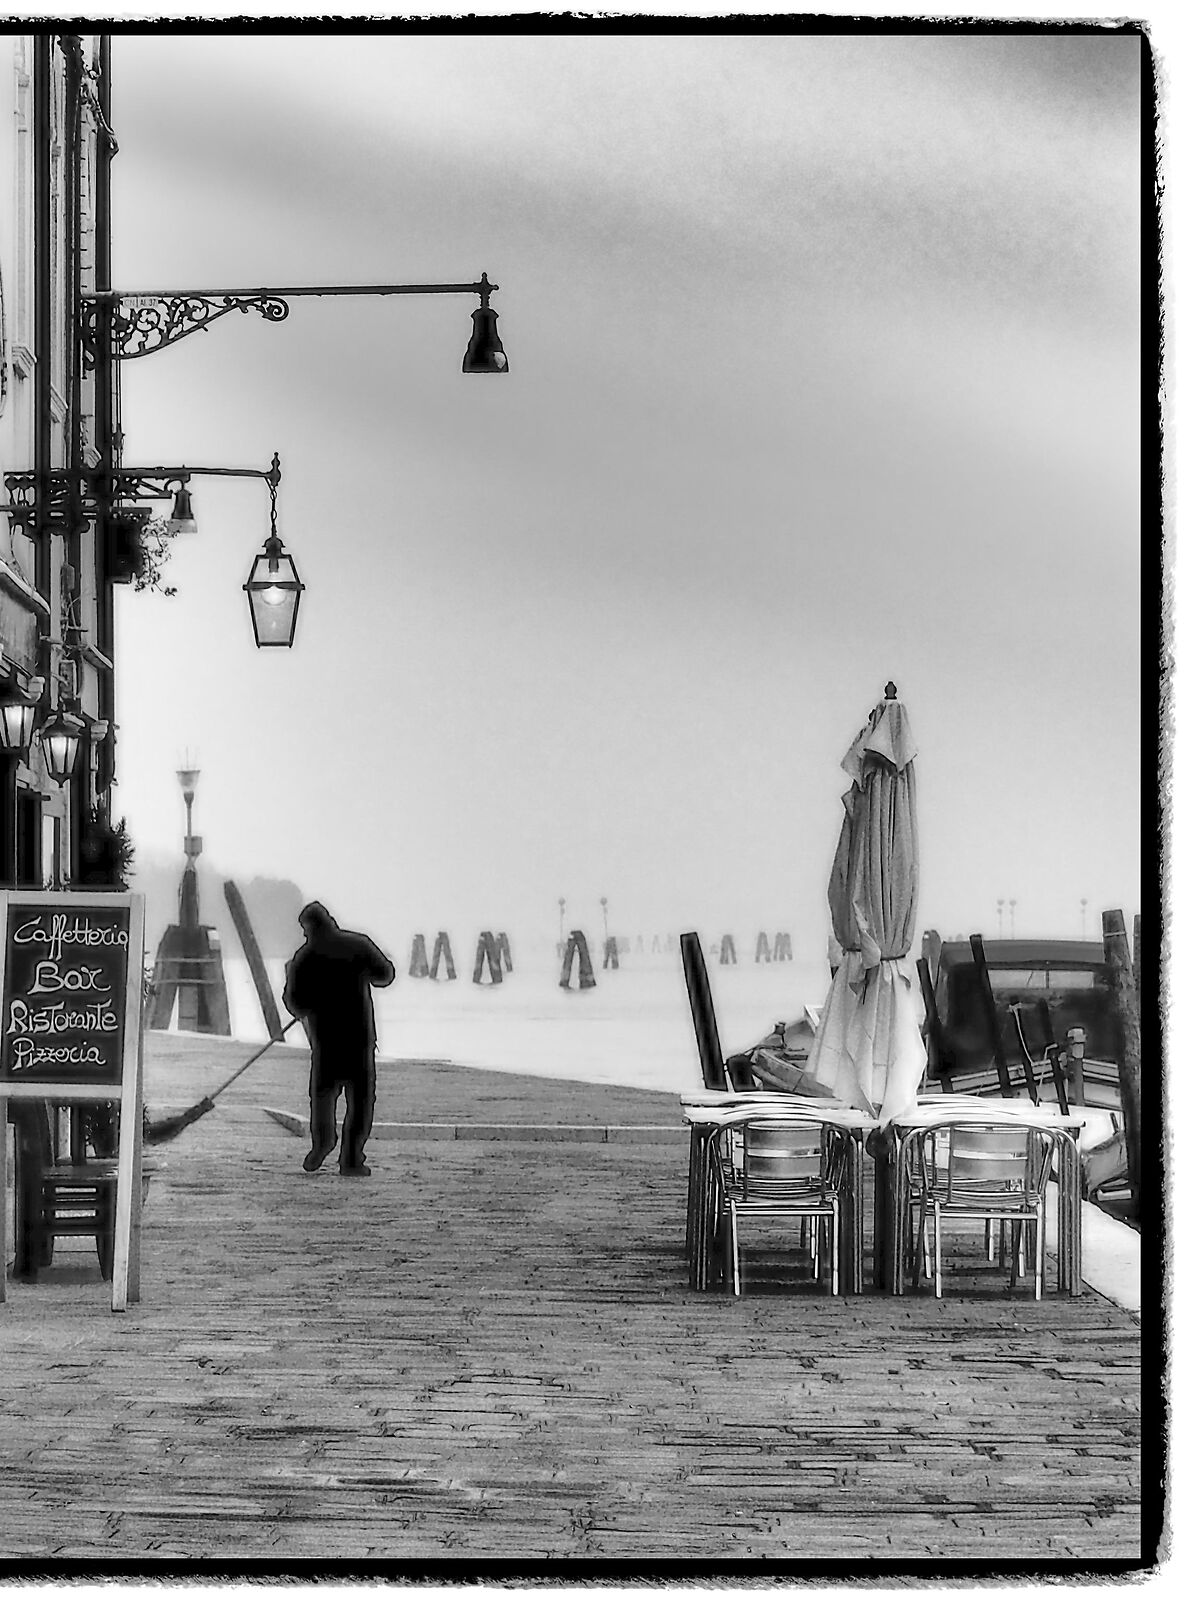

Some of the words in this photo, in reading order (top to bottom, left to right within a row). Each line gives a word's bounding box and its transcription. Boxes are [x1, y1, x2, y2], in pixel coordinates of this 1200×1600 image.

[13, 914, 129, 961] Caffetteria
[27, 961, 112, 994] Bar
[12, 1037, 107, 1071] Pizzeria
